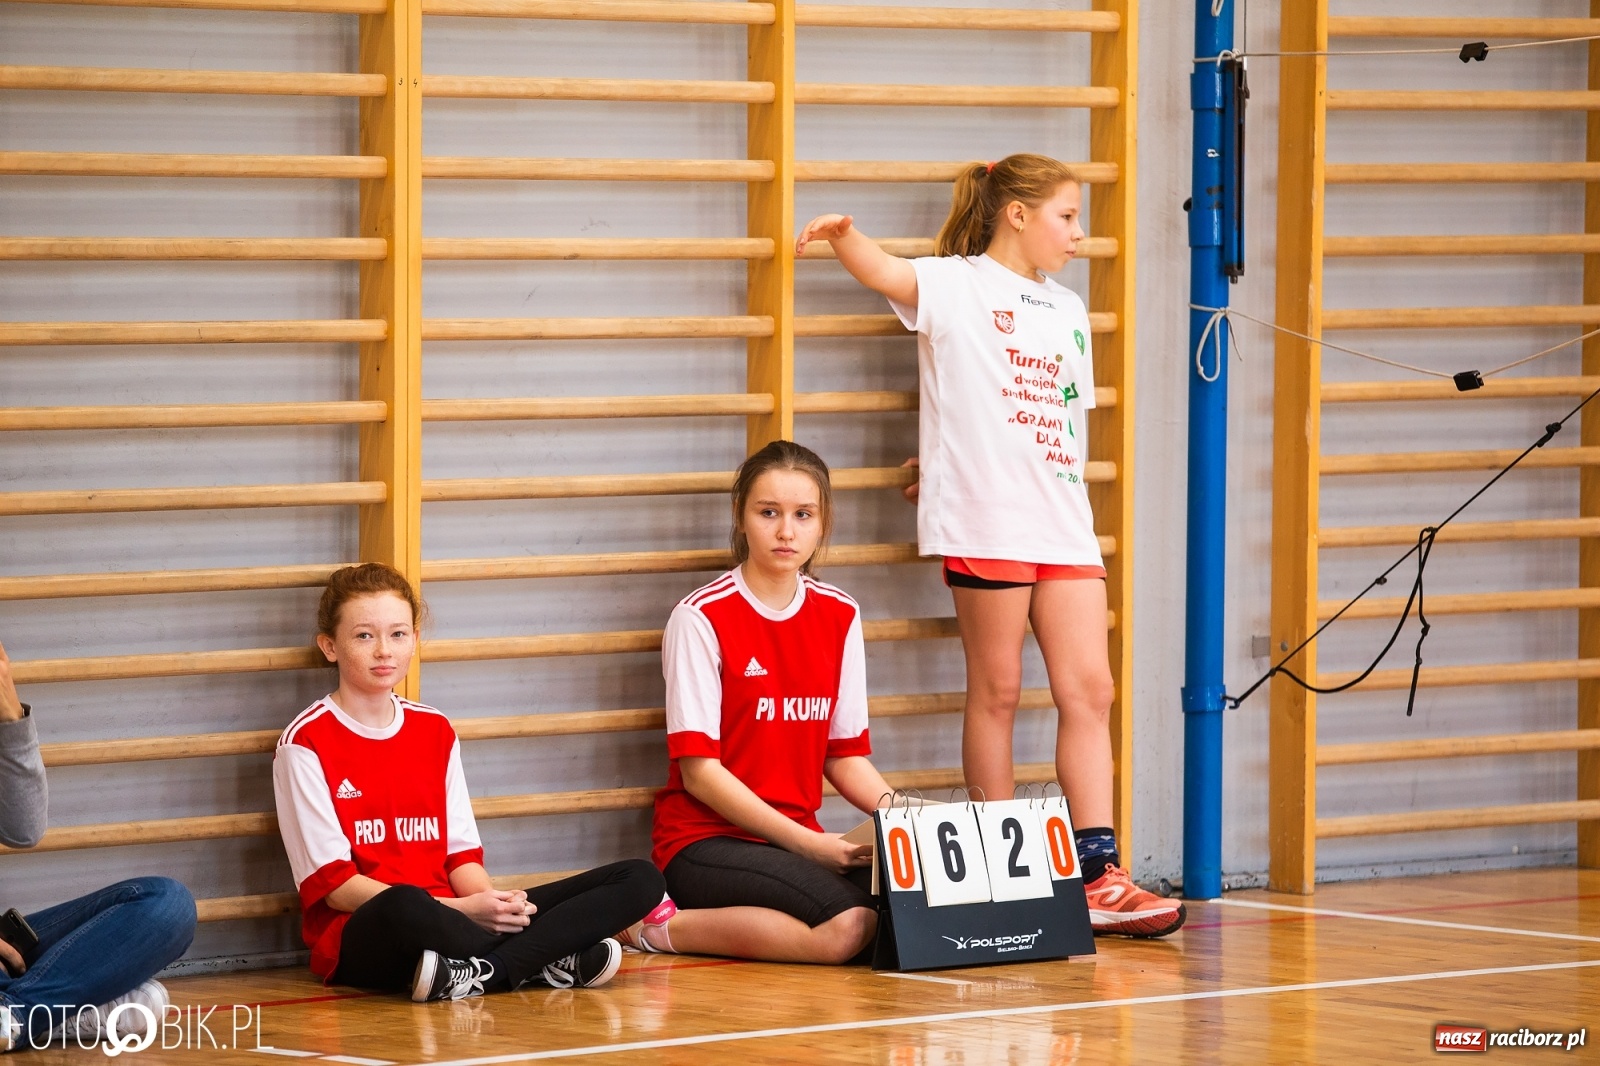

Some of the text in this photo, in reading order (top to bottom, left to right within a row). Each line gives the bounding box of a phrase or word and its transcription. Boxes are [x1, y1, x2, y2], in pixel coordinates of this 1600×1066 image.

[1036, 431, 1062, 448] DLA
[783, 697, 831, 721] KUHN
[336, 790, 363, 799] adidas
[354, 816, 440, 845] PRD KUHN
[888, 816, 1075, 889] 0 6 2 0
